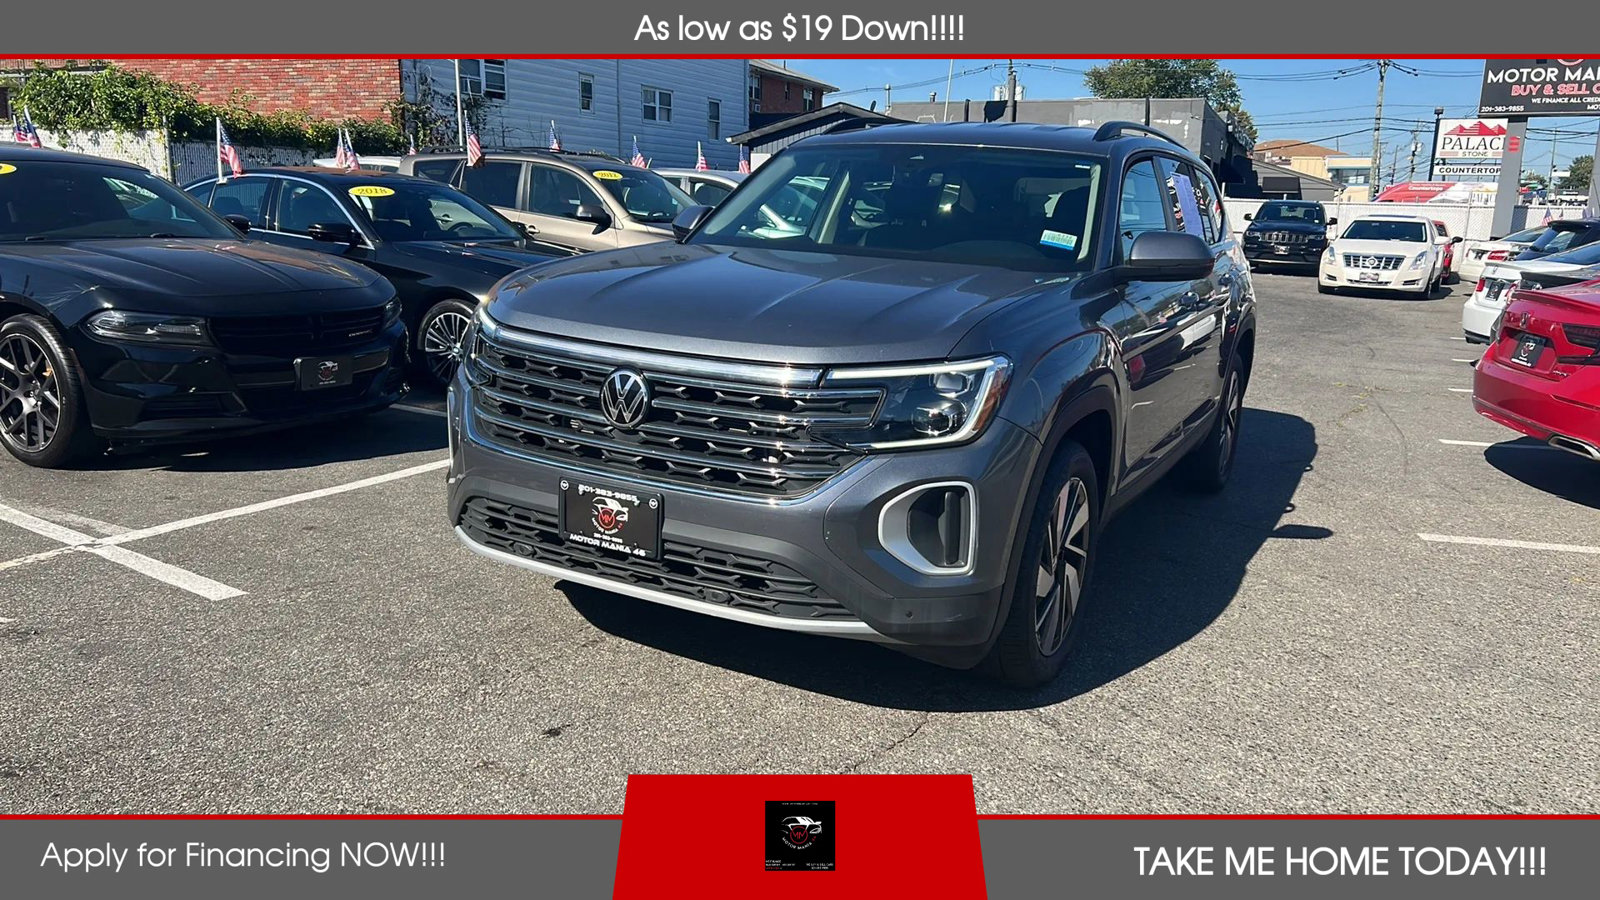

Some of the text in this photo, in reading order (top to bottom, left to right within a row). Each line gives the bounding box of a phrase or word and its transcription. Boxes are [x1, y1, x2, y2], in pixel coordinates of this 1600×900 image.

[1487, 68, 1559, 83] MOTOR
[1511, 85, 1541, 96] BUY
[1543, 85, 1554, 95] &
[1557, 83, 1590, 95] SELL
[1481, 105, 1525, 113] 201-383-9855
[569, 533, 600, 547] MOTOR
[601, 541, 632, 554] MANIA
